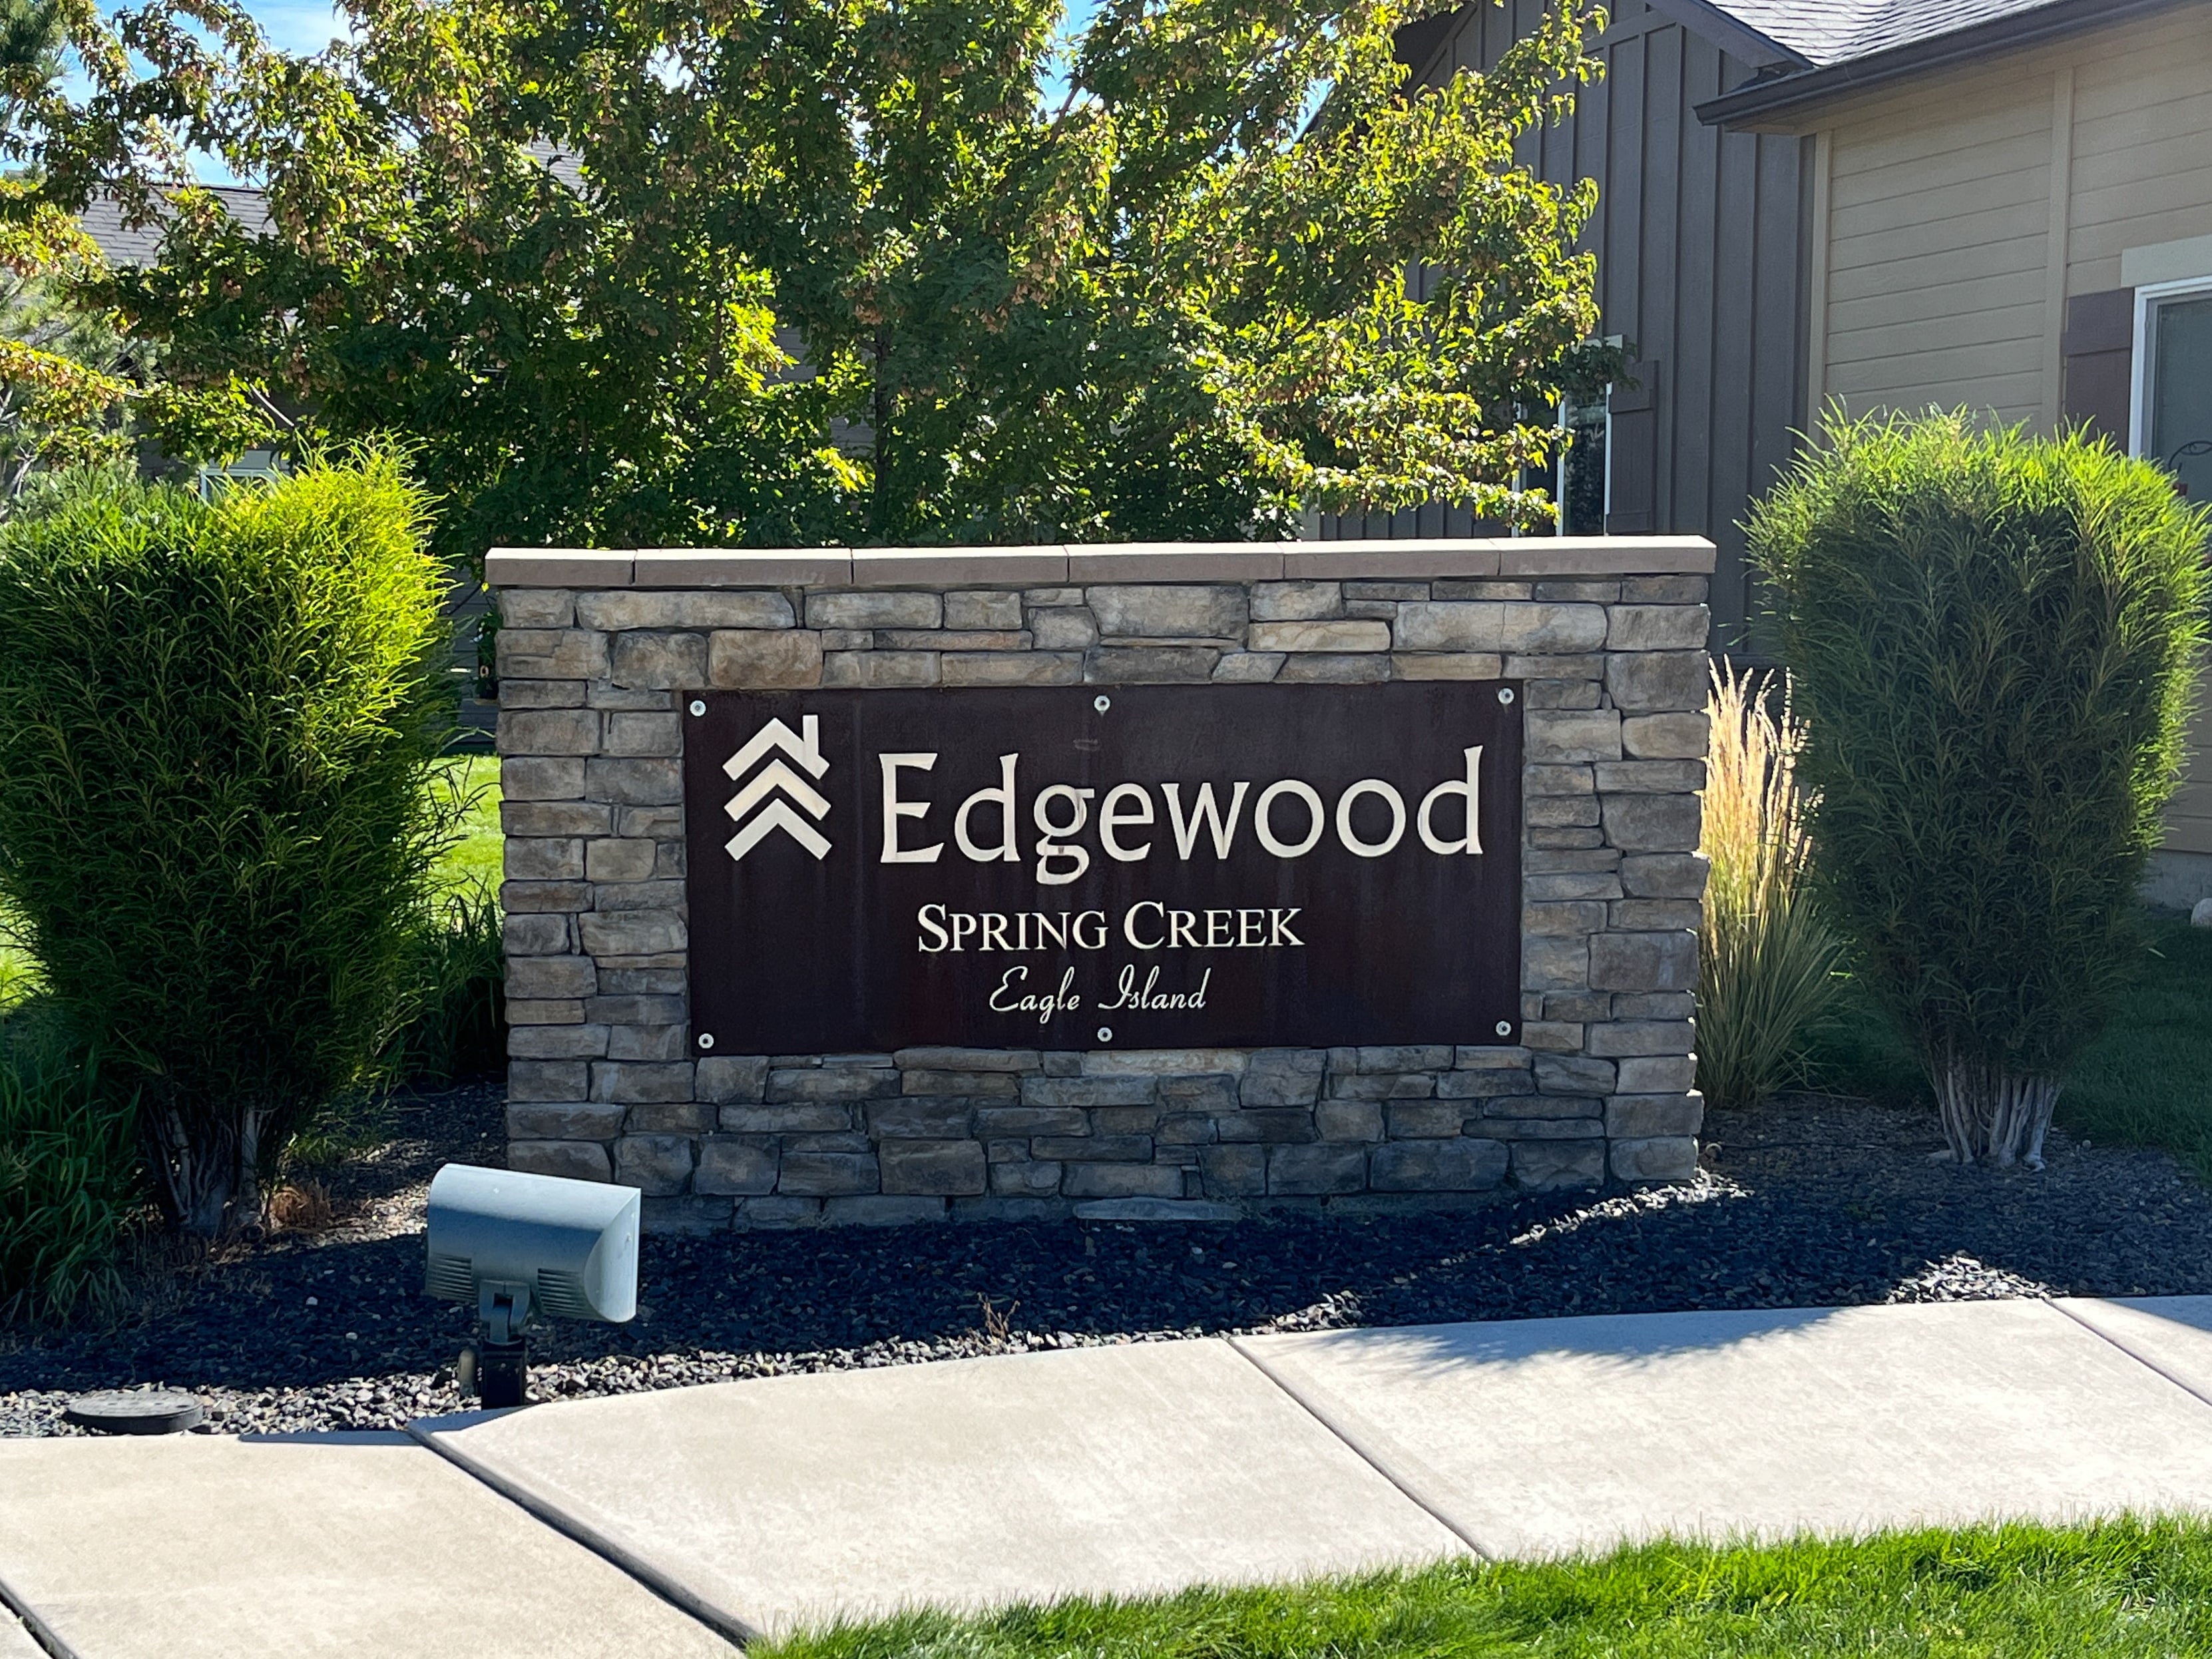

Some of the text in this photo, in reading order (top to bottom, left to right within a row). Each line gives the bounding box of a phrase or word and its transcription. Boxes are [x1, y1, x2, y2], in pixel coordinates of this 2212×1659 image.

[878, 745, 1484, 885] Edgewood
[917, 901, 1305, 952] SPRING CREEK
[989, 964, 1212, 1024] Eagle Island
